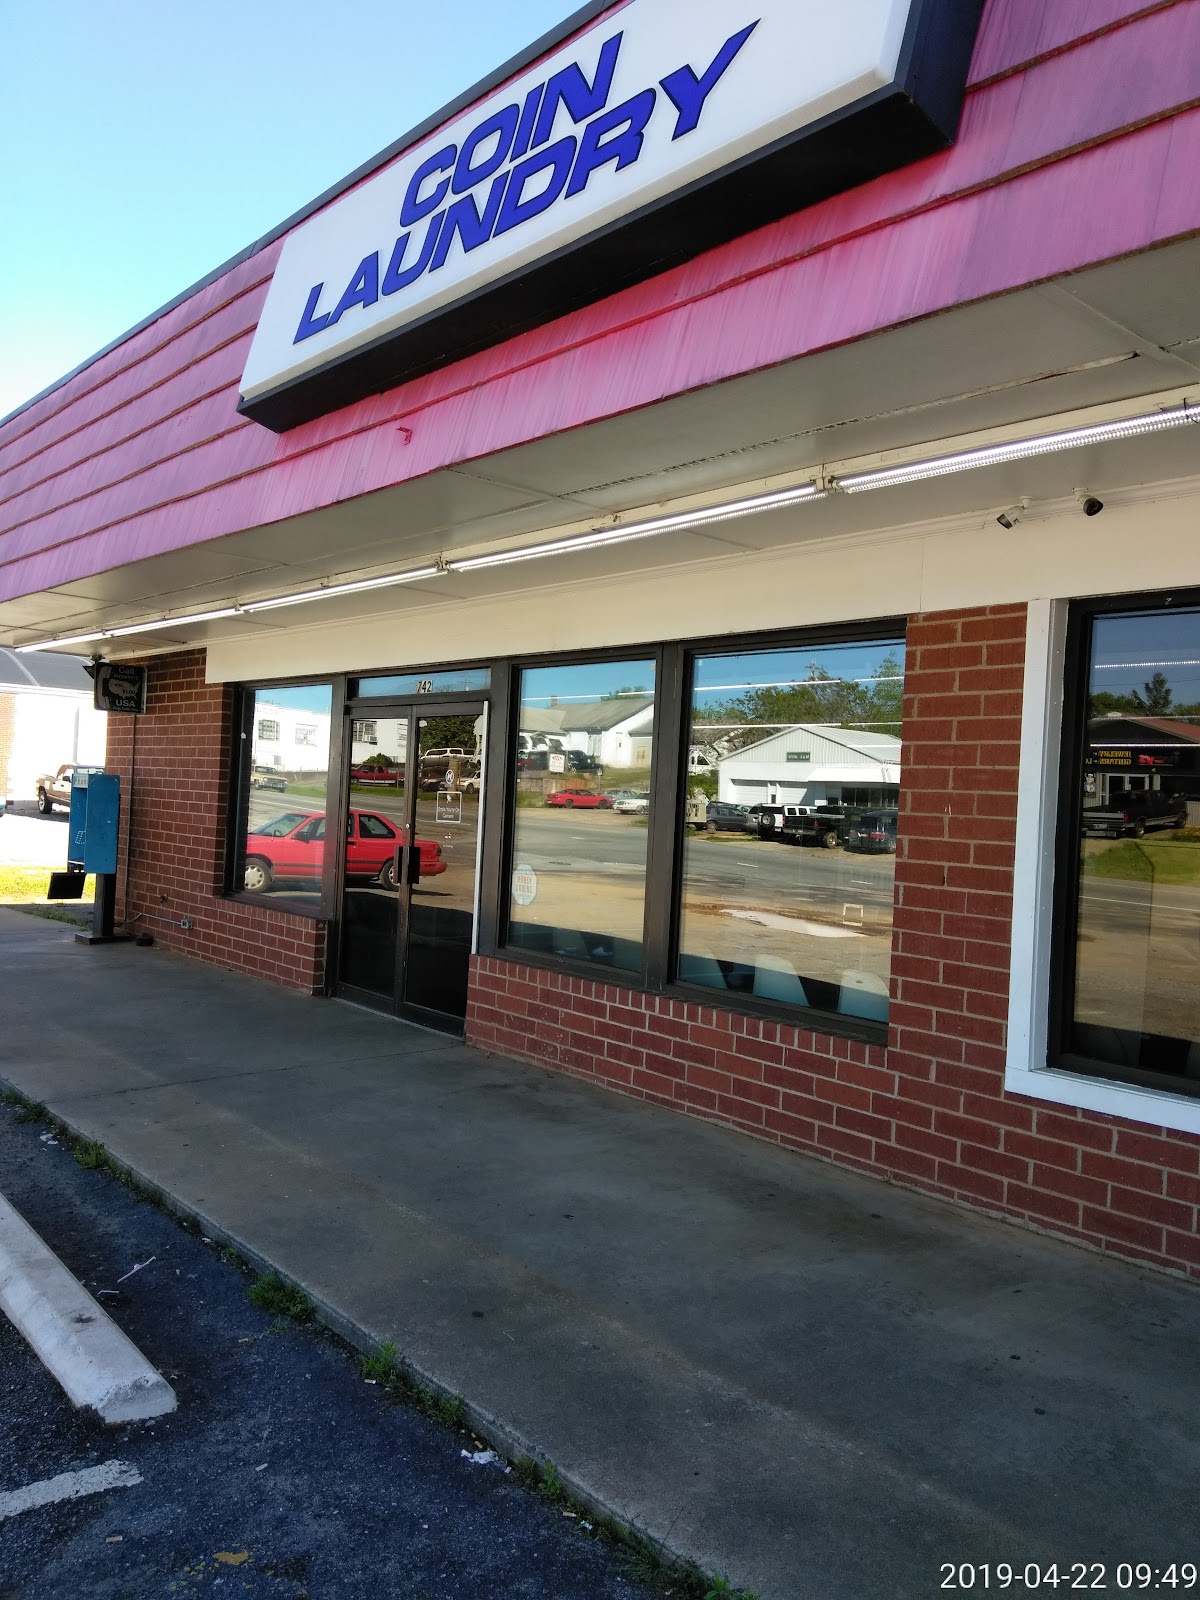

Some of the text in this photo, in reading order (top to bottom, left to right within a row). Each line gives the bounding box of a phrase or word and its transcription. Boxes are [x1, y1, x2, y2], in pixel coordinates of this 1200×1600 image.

[399, 30, 624, 228] COIN
[293, 18, 761, 345] LAUNDRY
[118, 666, 135, 676] Call
[416, 680, 432, 694] 742
[115, 699, 136, 709] USA
